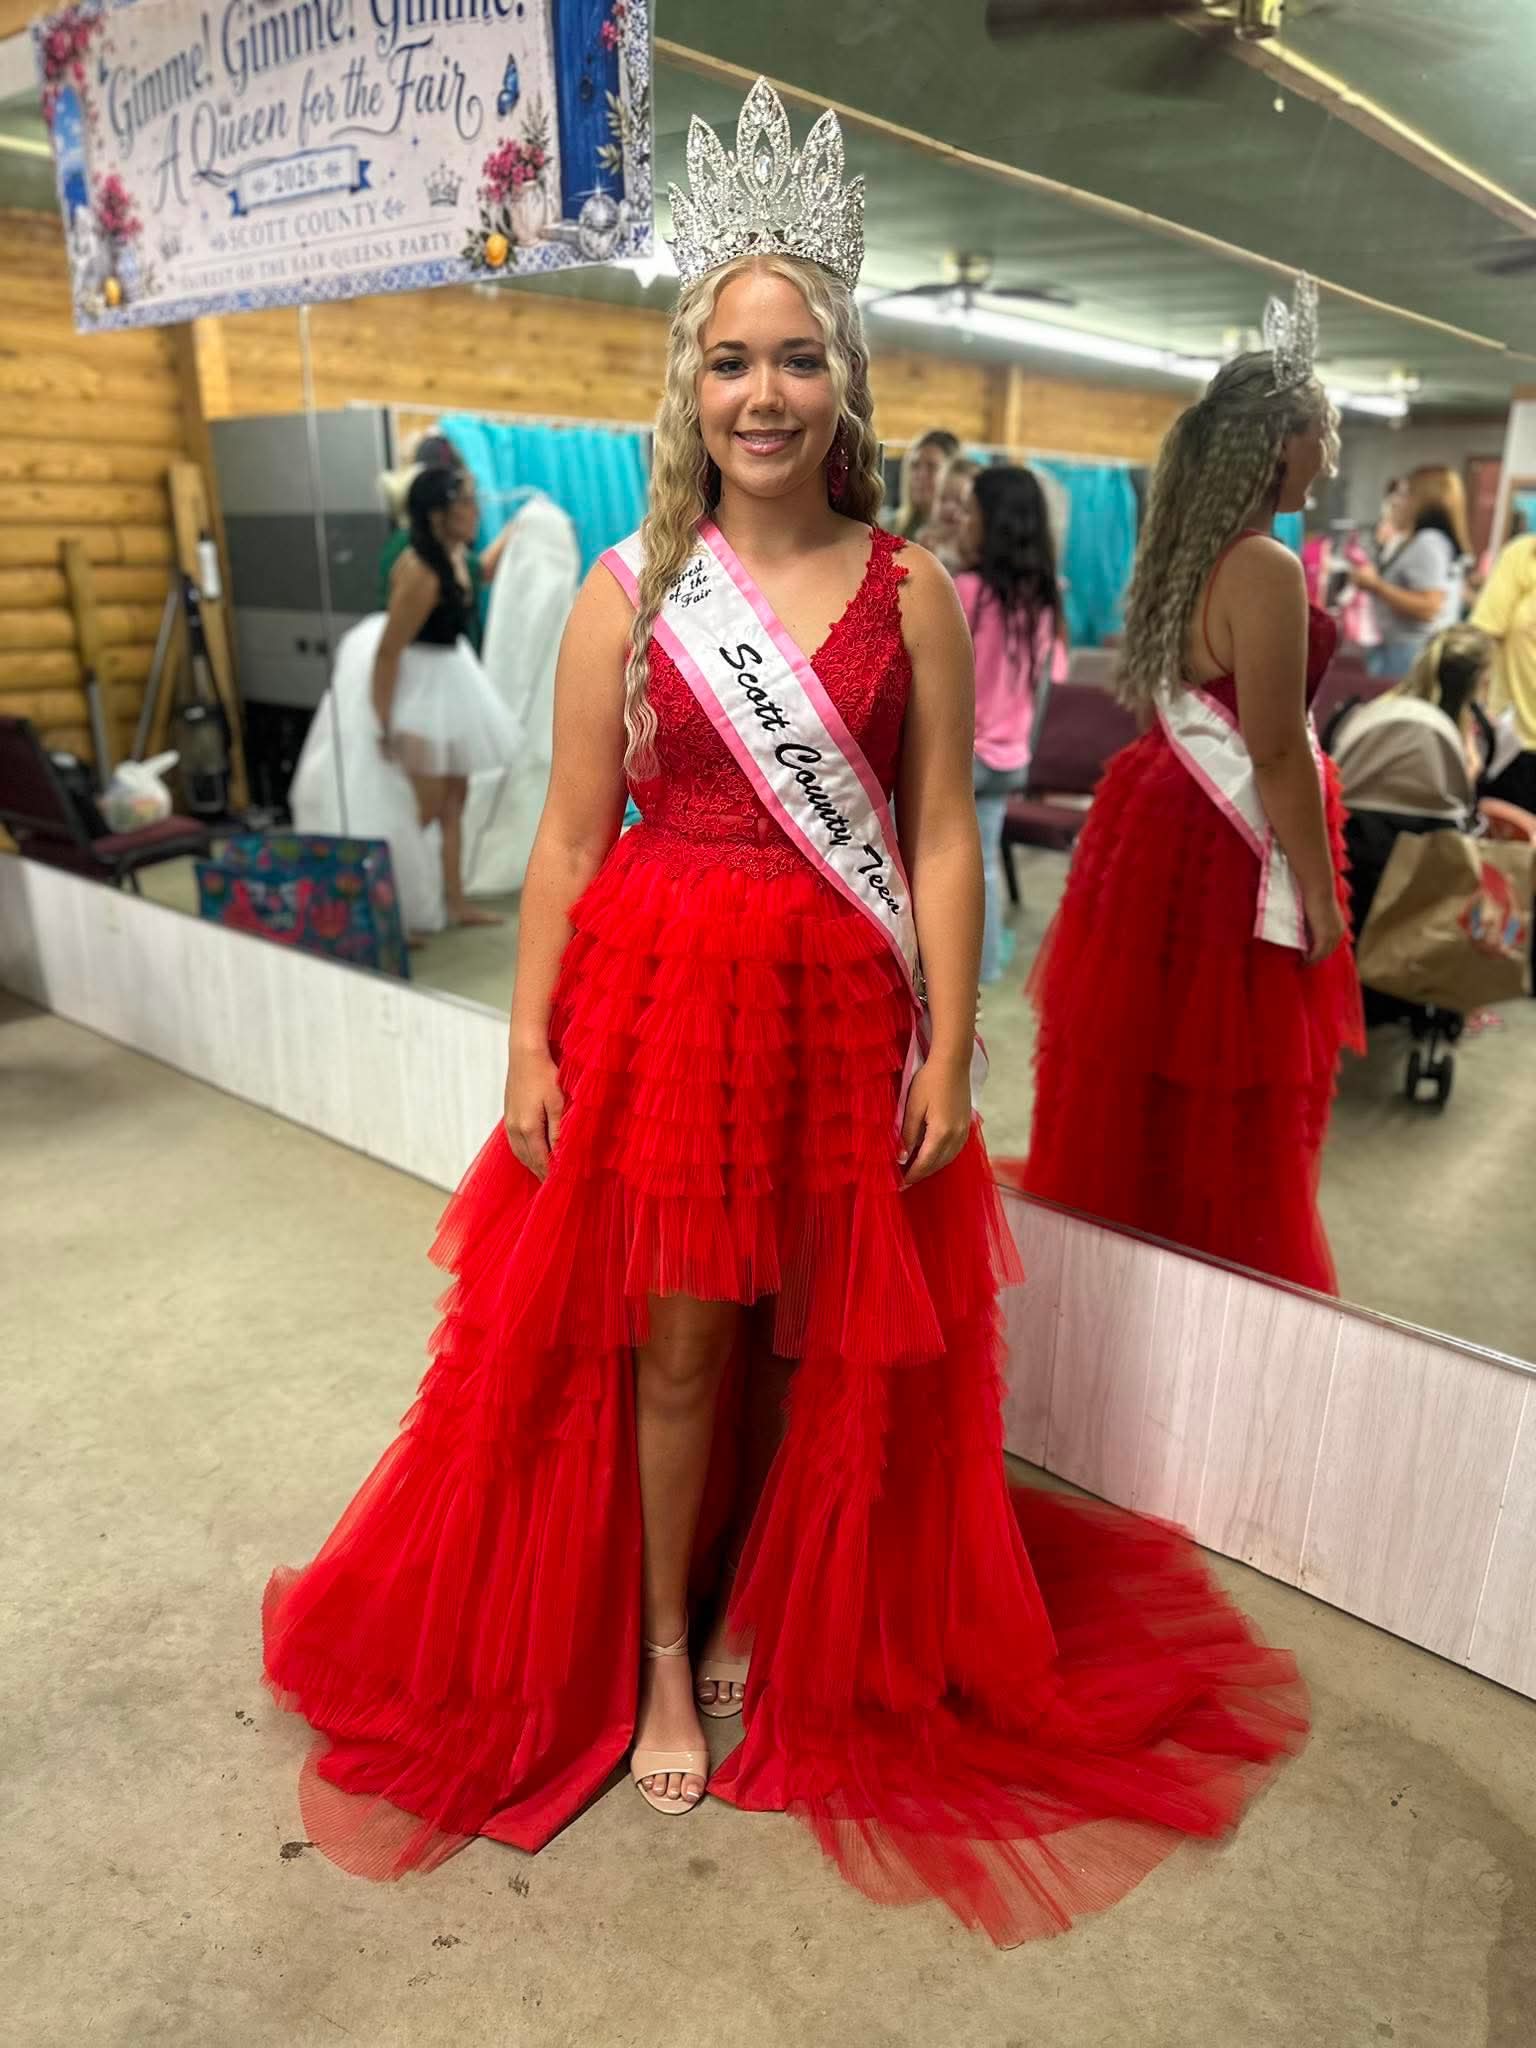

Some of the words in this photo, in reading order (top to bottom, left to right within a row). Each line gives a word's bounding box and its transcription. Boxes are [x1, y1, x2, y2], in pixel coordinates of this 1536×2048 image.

[108, 11, 213, 160] Gimme!
[299, 68, 336, 147] for
[330, 34, 484, 141] Fair
[341, 55, 385, 119] the
[153, 112, 189, 214] A
[190, 100, 287, 187] Queen
[272, 158, 319, 193] 2026
[228, 216, 287, 250] SCOTT
[294, 199, 378, 238] COUNTY
[398, 231, 452, 257] PARTY
[669, 560, 704, 588] airest
[669, 585, 681, 603] of
[690, 573, 709, 590] the
[680, 588, 712, 608] Fair
[718, 642, 790, 732] Scott
[775, 743, 853, 847] County
[862, 843, 900, 916] Teen
